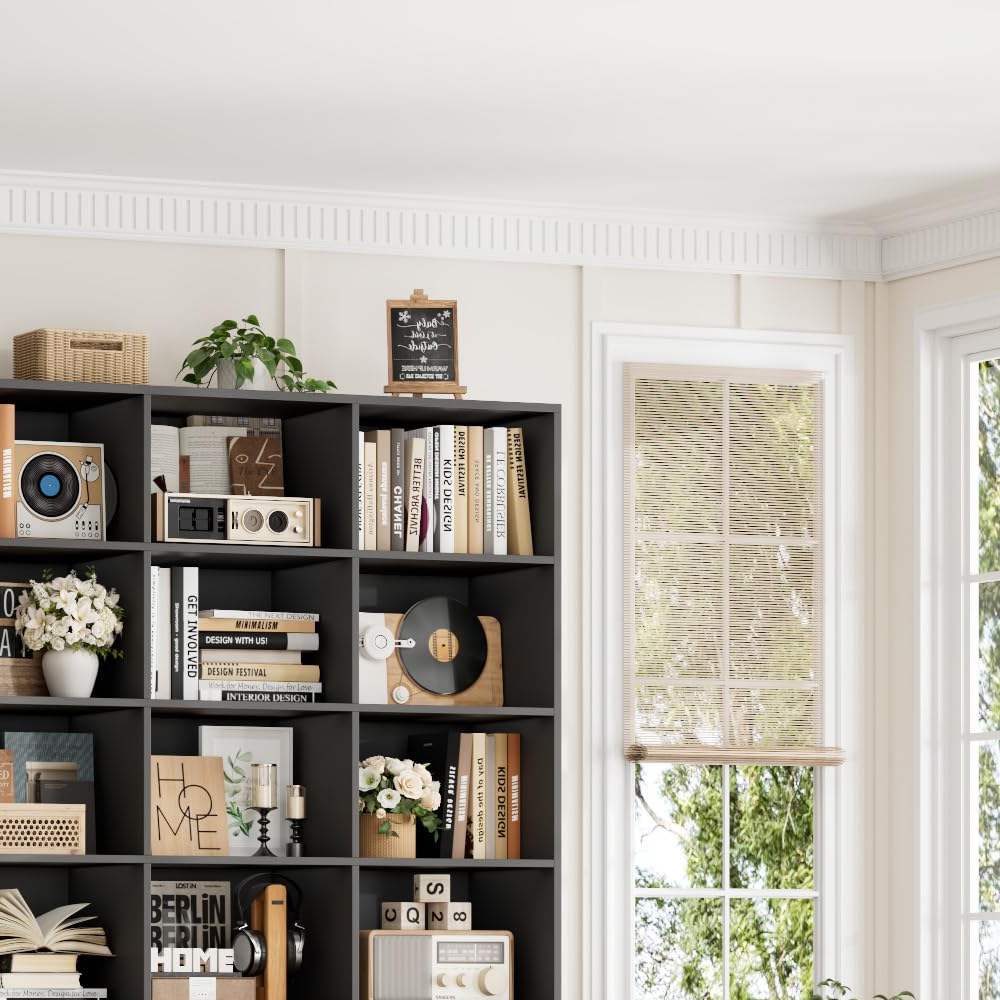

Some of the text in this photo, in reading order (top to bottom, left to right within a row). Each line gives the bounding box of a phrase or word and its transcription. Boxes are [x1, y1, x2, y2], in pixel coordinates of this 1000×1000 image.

[235, 620, 279, 630] MINIMALISM
[188, 596, 197, 678] GET INVOLVED
[206, 636, 267, 645] DESIGN WITH US!
[207, 667, 266, 676] DESIGN FESTIVAL
[227, 693, 307, 702] INTERIOR DESIGN
[151, 947, 234, 973] HOME
